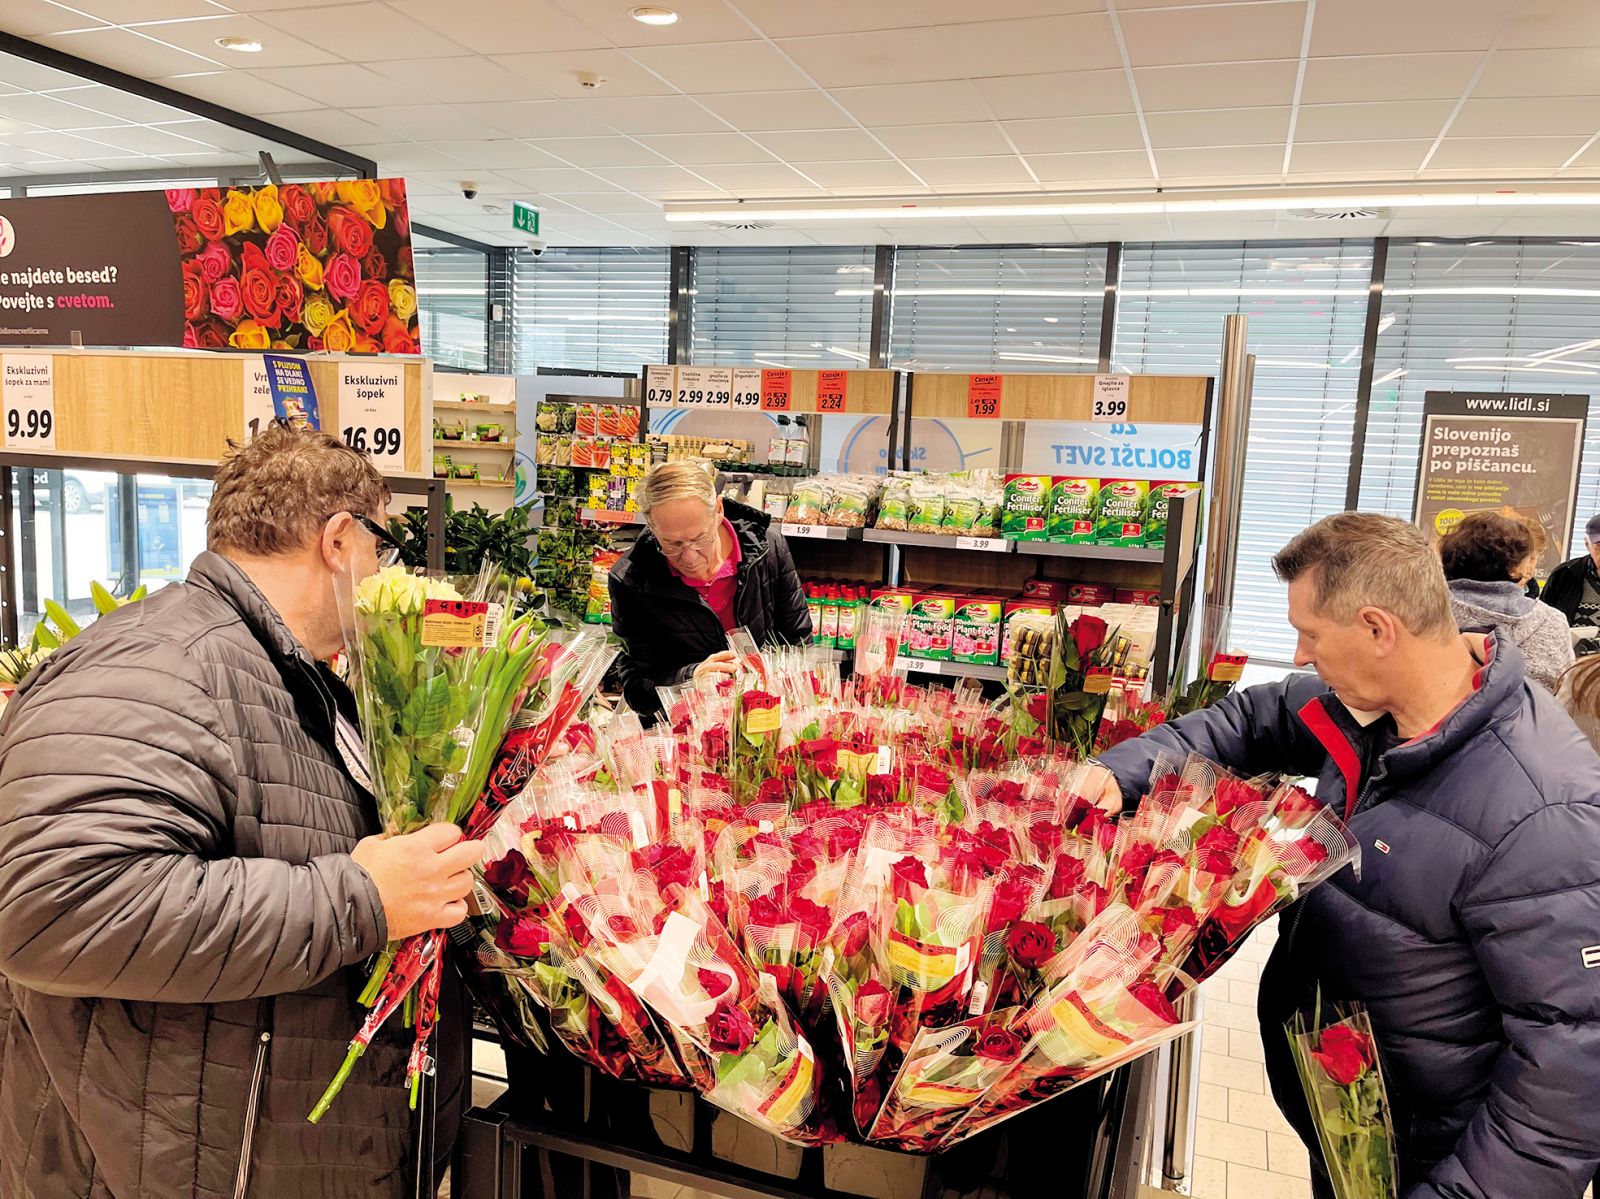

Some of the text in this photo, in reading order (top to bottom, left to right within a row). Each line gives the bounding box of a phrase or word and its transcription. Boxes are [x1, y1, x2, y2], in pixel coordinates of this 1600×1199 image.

[0, 265, 118, 289] e najdete besed?
[46, 296, 55, 309] s
[57, 293, 115, 309] cvetom.
[6, 365, 48, 375] Ekskluzivni
[254, 372, 268, 381] Vrt
[344, 375, 398, 386] Ekskluzivni
[254, 386, 270, 394] zele
[356, 388, 385, 400] šopek
[648, 388, 672, 402] 0.79
[678, 390, 703, 403] 2.99
[706, 391, 730, 404] 2.99
[734, 392, 760, 406] 4.99
[766, 397, 786, 408] 2.99
[821, 399, 841, 409] 2.24
[1466, 397, 1551, 412] www.lidl.si
[974, 404, 995, 415] 1.99
[1094, 401, 1126, 416] 3.99
[8, 408, 52, 438] 9.99
[343, 426, 401, 455] 16.99
[1433, 426, 1512, 444] Slovenijo
[1431, 444, 1520, 458] prepoznaš
[1430, 457, 1537, 474] po piščancu.
[1010, 493, 1041, 503] Conifer
[1057, 496, 1089, 506] Conifer
[1105, 498, 1138, 508] Conifer
[1007, 501, 1044, 512] Fertiliser
[1053, 504, 1092, 515] Fertiliser
[1102, 507, 1141, 518] Fertiliser
[797, 526, 811, 535] 1.99
[973, 539, 990, 548] 3.99
[912, 620, 951, 631] Plant Food
[956, 624, 997, 636] Plant Food
[908, 660, 924, 669] 3.99
